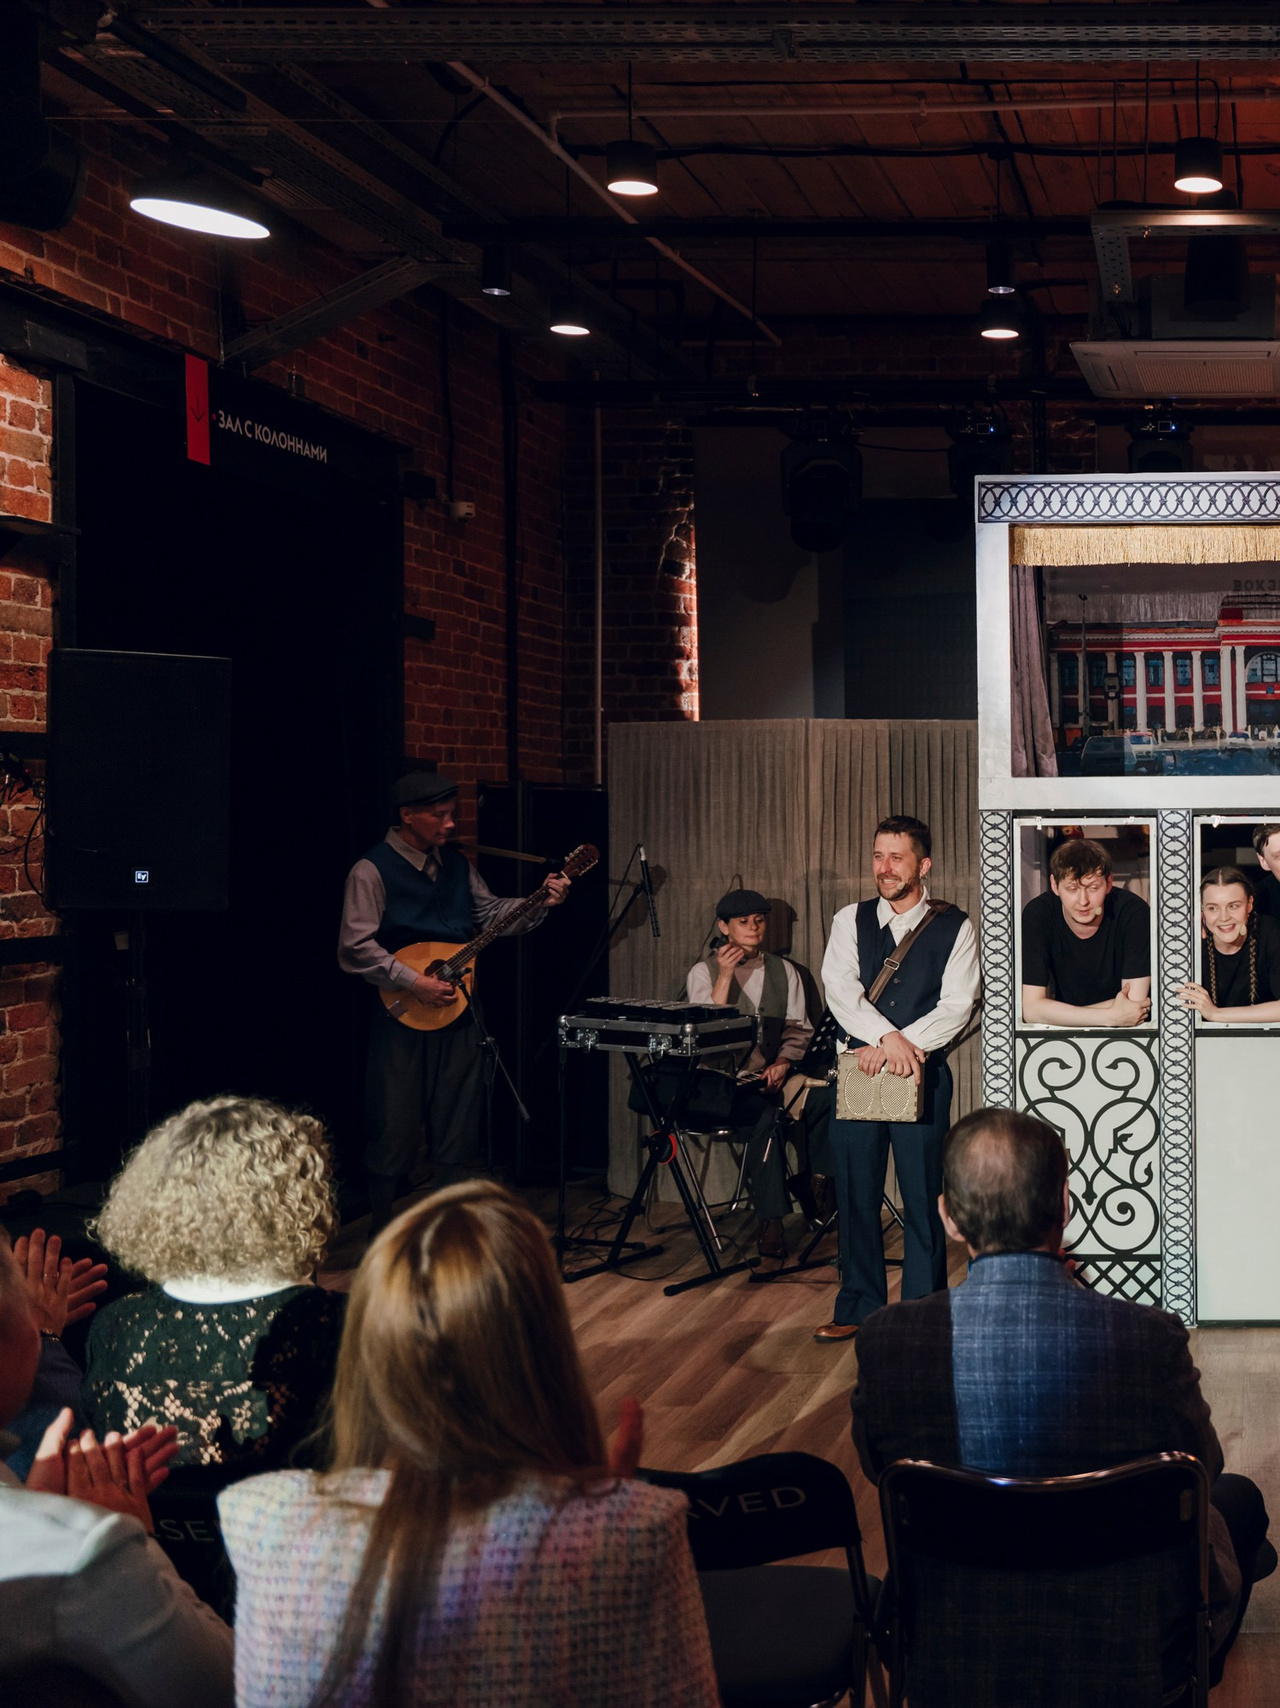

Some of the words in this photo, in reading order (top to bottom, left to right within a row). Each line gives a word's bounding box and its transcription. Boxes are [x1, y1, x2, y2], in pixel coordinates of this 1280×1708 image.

[218, 410, 243, 435] ЗАЛ
[244, 420, 253, 438] С
[254, 423, 328, 463] КОЛОННАМИ
